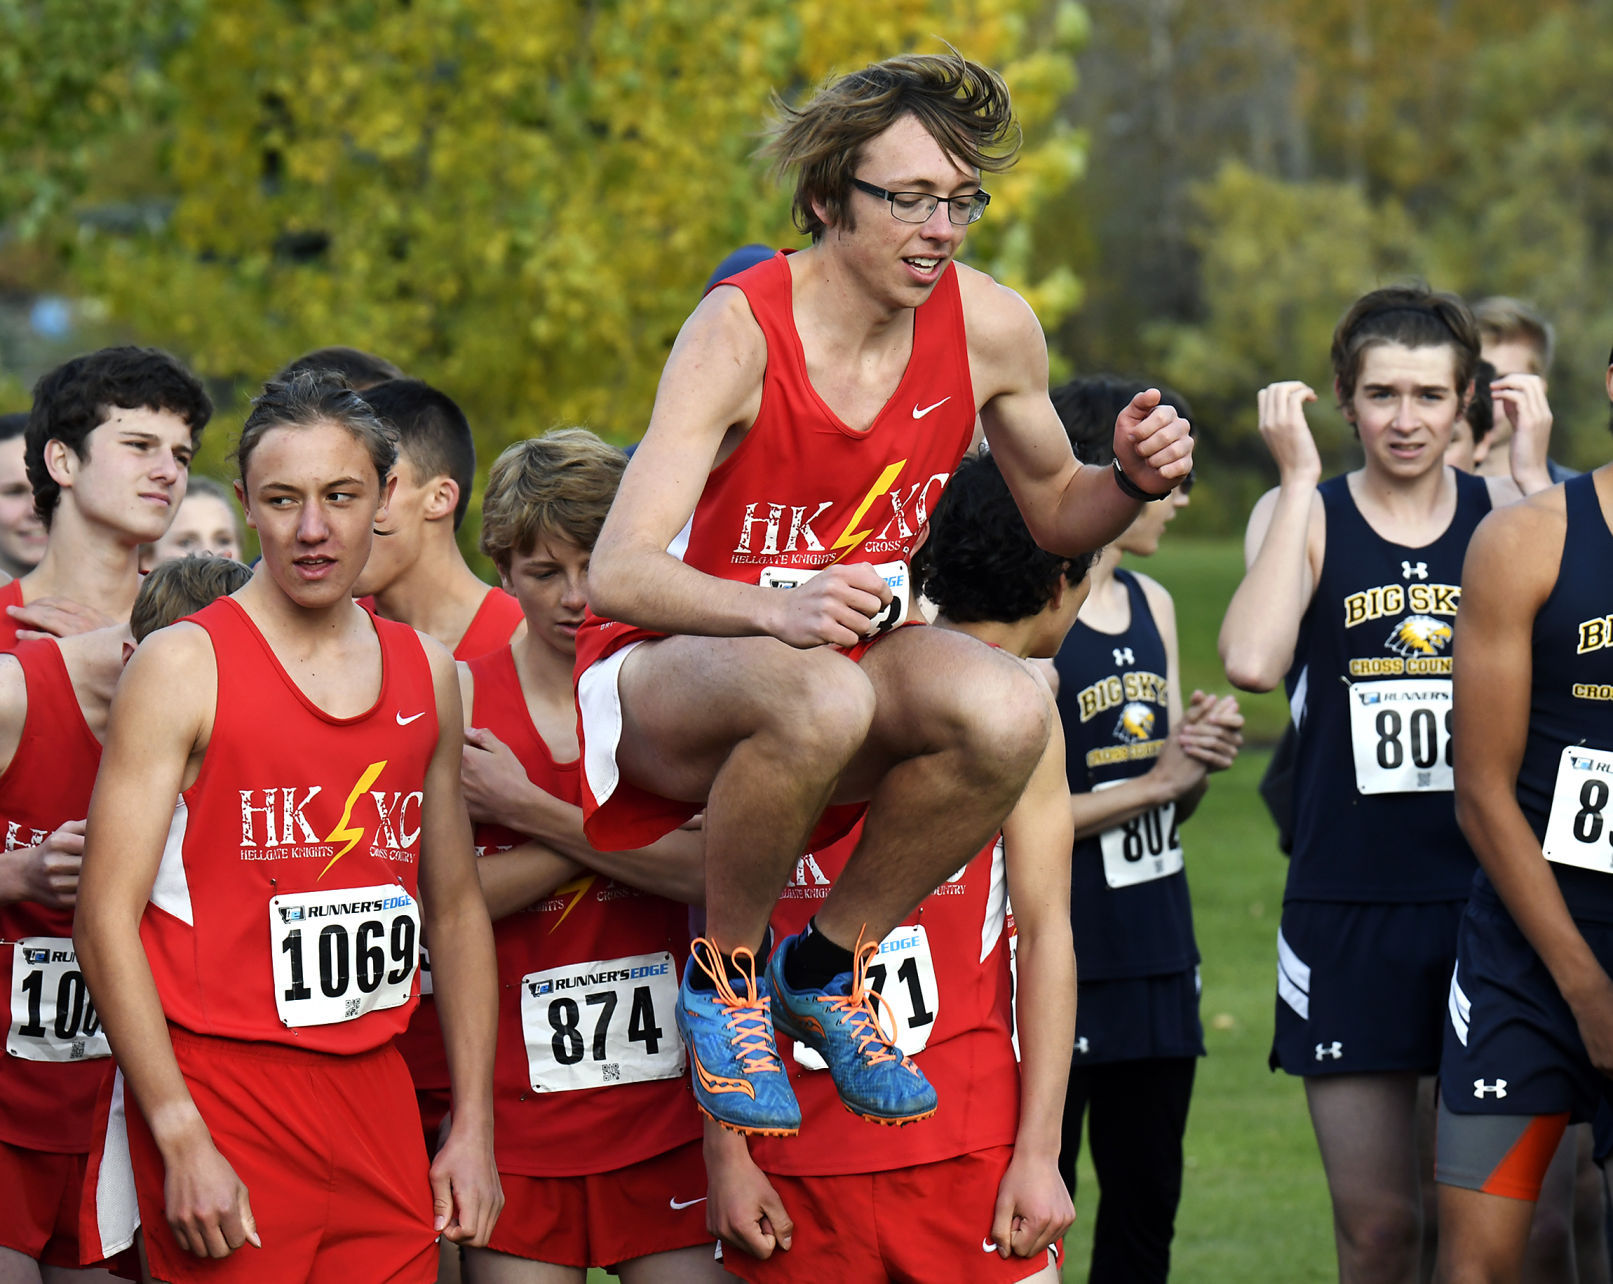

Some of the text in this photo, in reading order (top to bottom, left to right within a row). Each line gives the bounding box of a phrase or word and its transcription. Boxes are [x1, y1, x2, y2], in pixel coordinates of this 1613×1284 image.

[733, 473, 950, 555] HK XC
[730, 554, 788, 565] HELLGATE
[791, 552, 837, 565] KNIGHTS
[865, 541, 900, 552] CROSS
[1344, 584, 1461, 628] BIG SK
[1350, 657, 1453, 676] CROSS COUN
[1077, 671, 1167, 722] BIG SKY
[1572, 683, 1613, 701] CRO
[239, 786, 424, 849] HK XC
[240, 849, 289, 861] HELLGATE
[291, 846, 334, 859] KNIGHTS
[282, 914, 415, 1002] 1069
[547, 985, 663, 1066] 874
